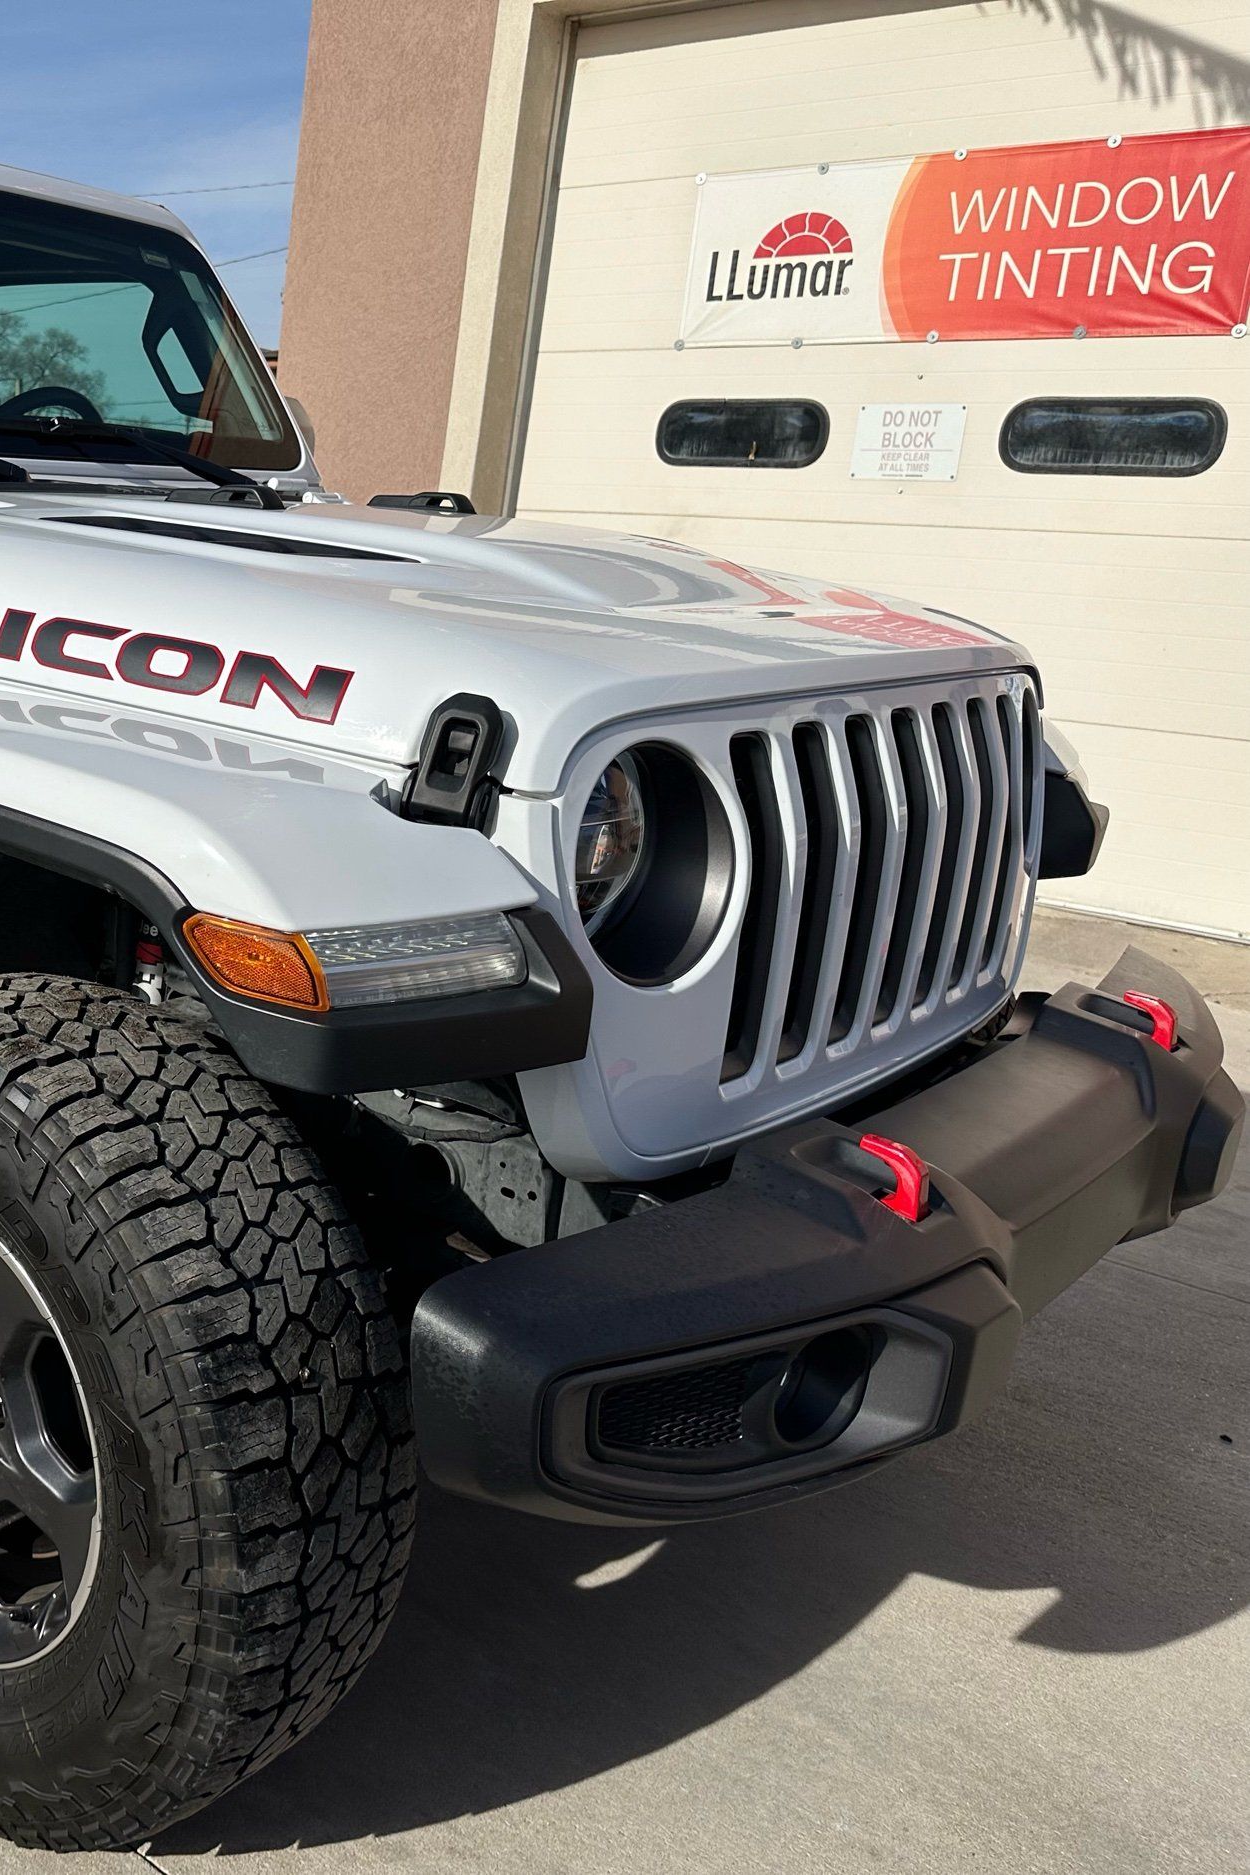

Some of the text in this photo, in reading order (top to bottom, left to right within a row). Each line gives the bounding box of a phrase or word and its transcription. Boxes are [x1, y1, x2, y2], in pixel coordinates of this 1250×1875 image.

[949, 170, 1236, 235] WINDOW
[705, 249, 854, 303] LLumar
[938, 240, 1217, 302] TINTING
[882, 409, 943, 428] DO NOT
[881, 431, 936, 449] BLOCK
[880, 452, 930, 462] KEEP CLEAR
[878, 462, 930, 473] AT ALL TIMES
